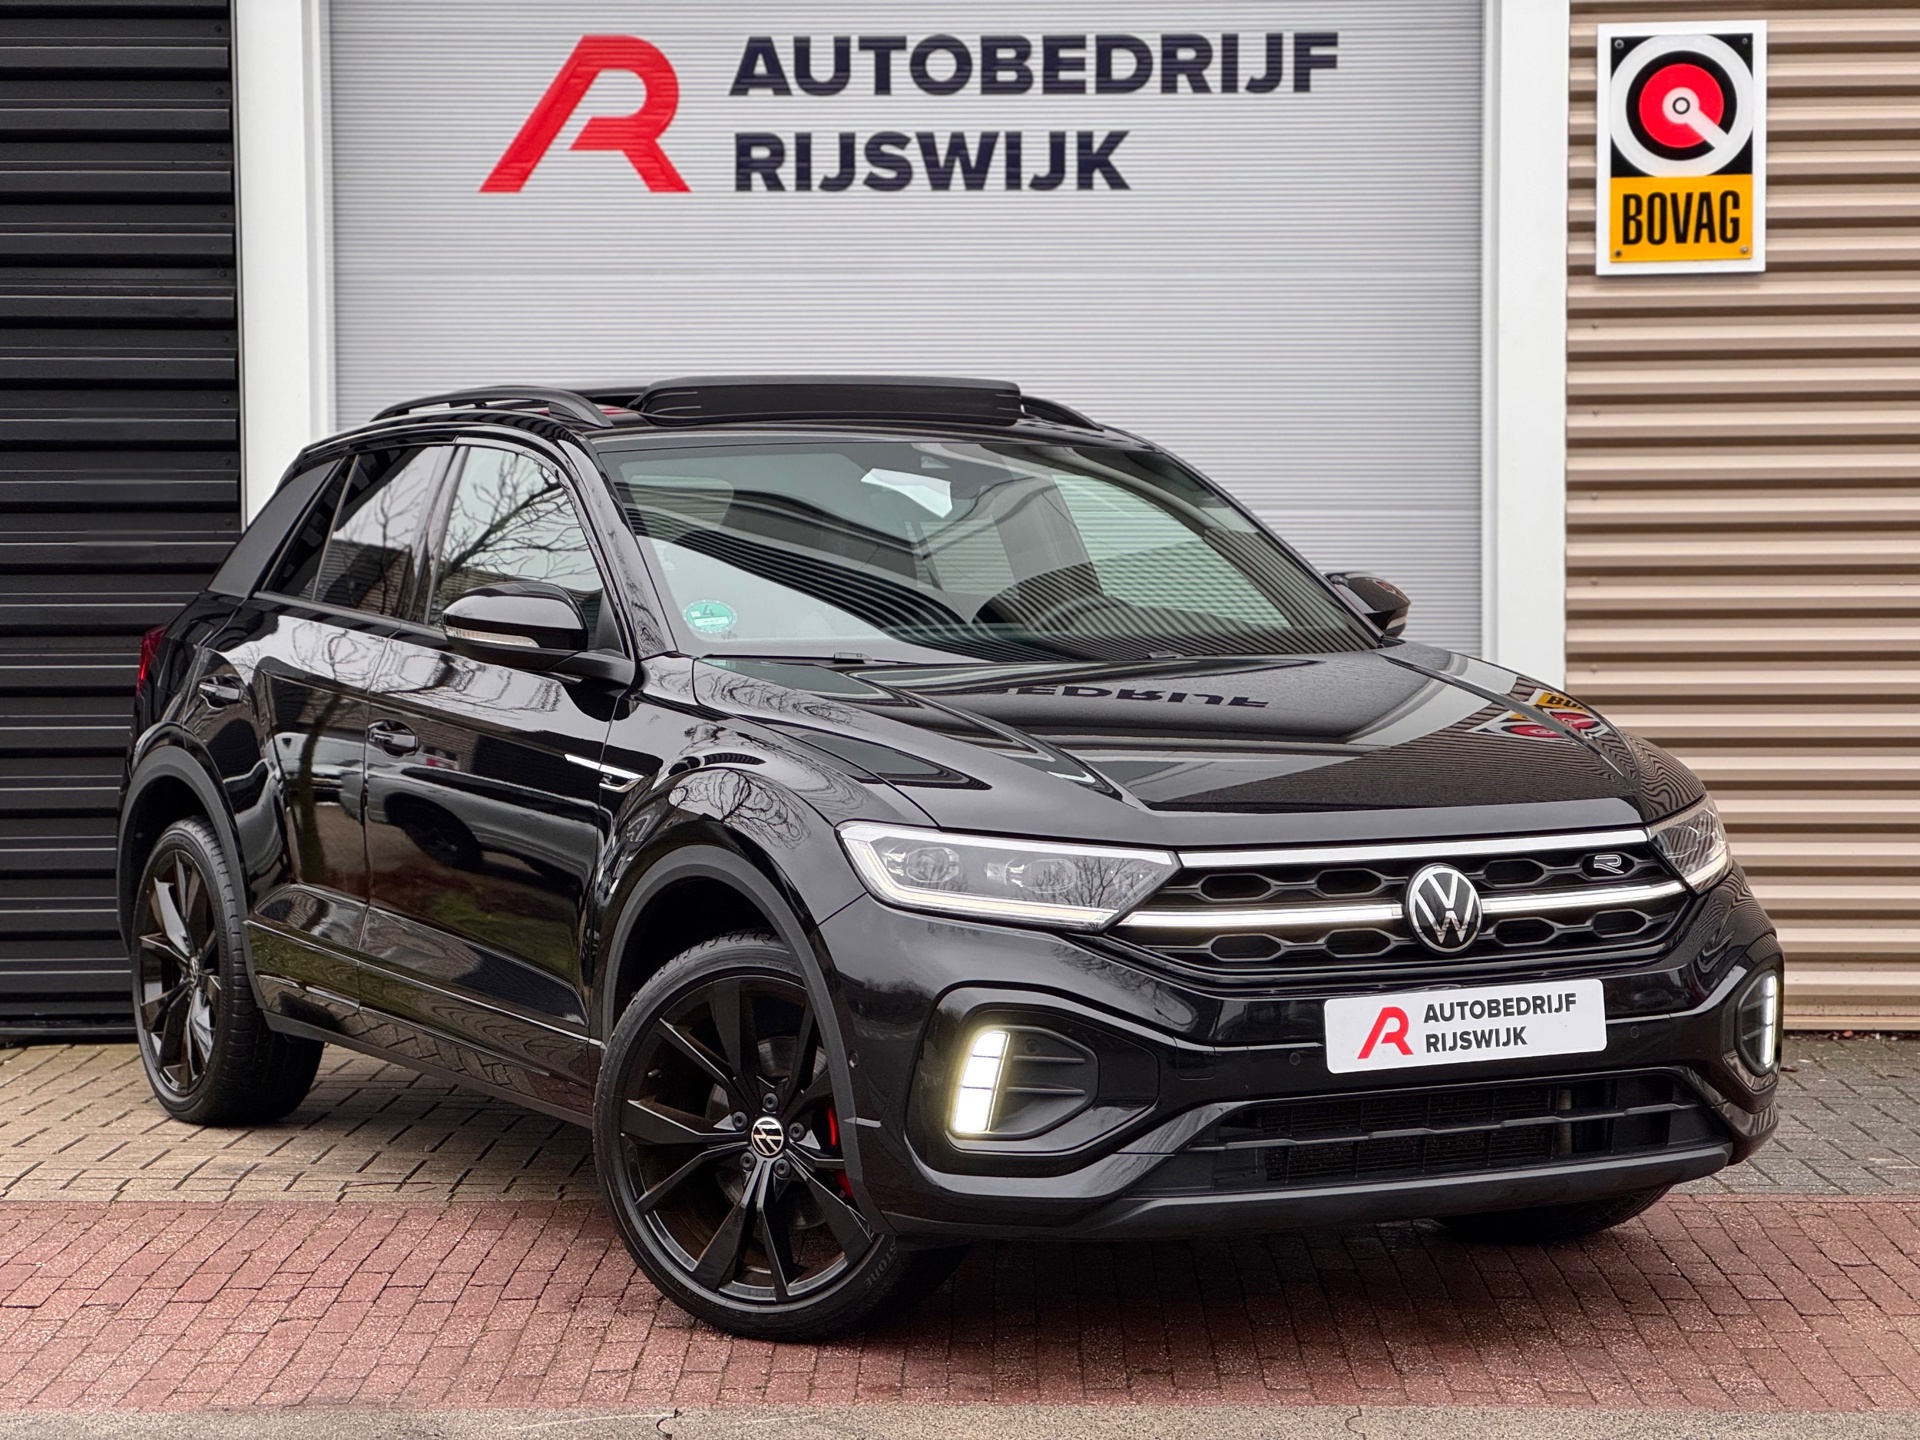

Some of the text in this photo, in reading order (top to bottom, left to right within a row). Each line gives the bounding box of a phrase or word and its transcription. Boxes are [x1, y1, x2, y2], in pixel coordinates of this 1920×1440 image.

[730, 32, 1338, 97] AUTOBEDRIJF
[735, 130, 1130, 192] RIJSWIJK
[1622, 189, 1740, 246] BOVAG
[1423, 992, 1577, 1023] AUTOBEDRIJF
[1425, 1025, 1528, 1054] RIJSWIJK
